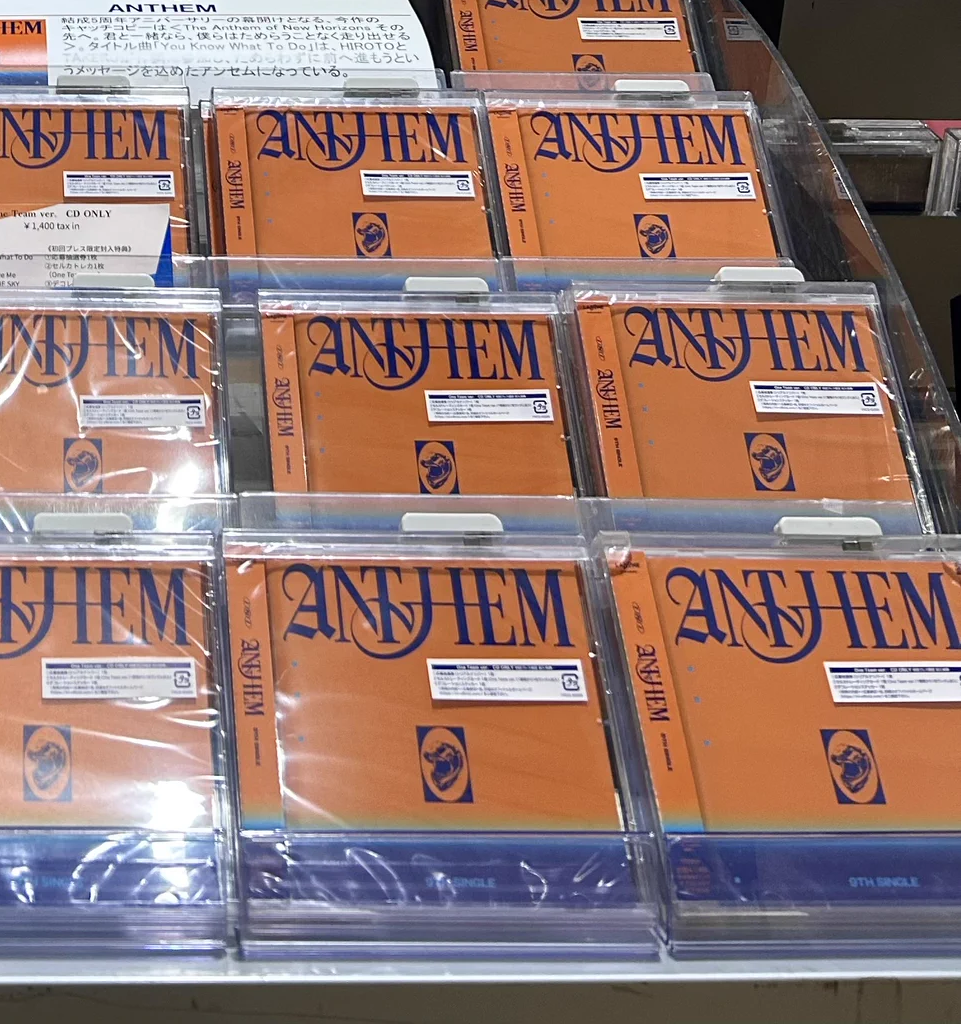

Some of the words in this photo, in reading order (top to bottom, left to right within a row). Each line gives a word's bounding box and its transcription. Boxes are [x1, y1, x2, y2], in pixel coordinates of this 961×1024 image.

[108, 3, 217, 13] ANTHEM
[376, 24, 404, 32] その
[190, 42, 227, 51] Know
[230, 42, 263, 51] What
[267, 42, 284, 51] To
[256, 109, 469, 172] ANTHEM
[530, 110, 746, 173] ANTHEM
[12, 209, 37, 218] Team
[66, 209, 81, 218] CD
[83, 209, 112, 218] ONLY
[57, 222, 70, 230] tax
[72, 222, 80, 230] in
[307, 315, 546, 391] ANTHEM
[623, 306, 870, 382] ANTHEM
[282, 563, 576, 660] ANTHEM
